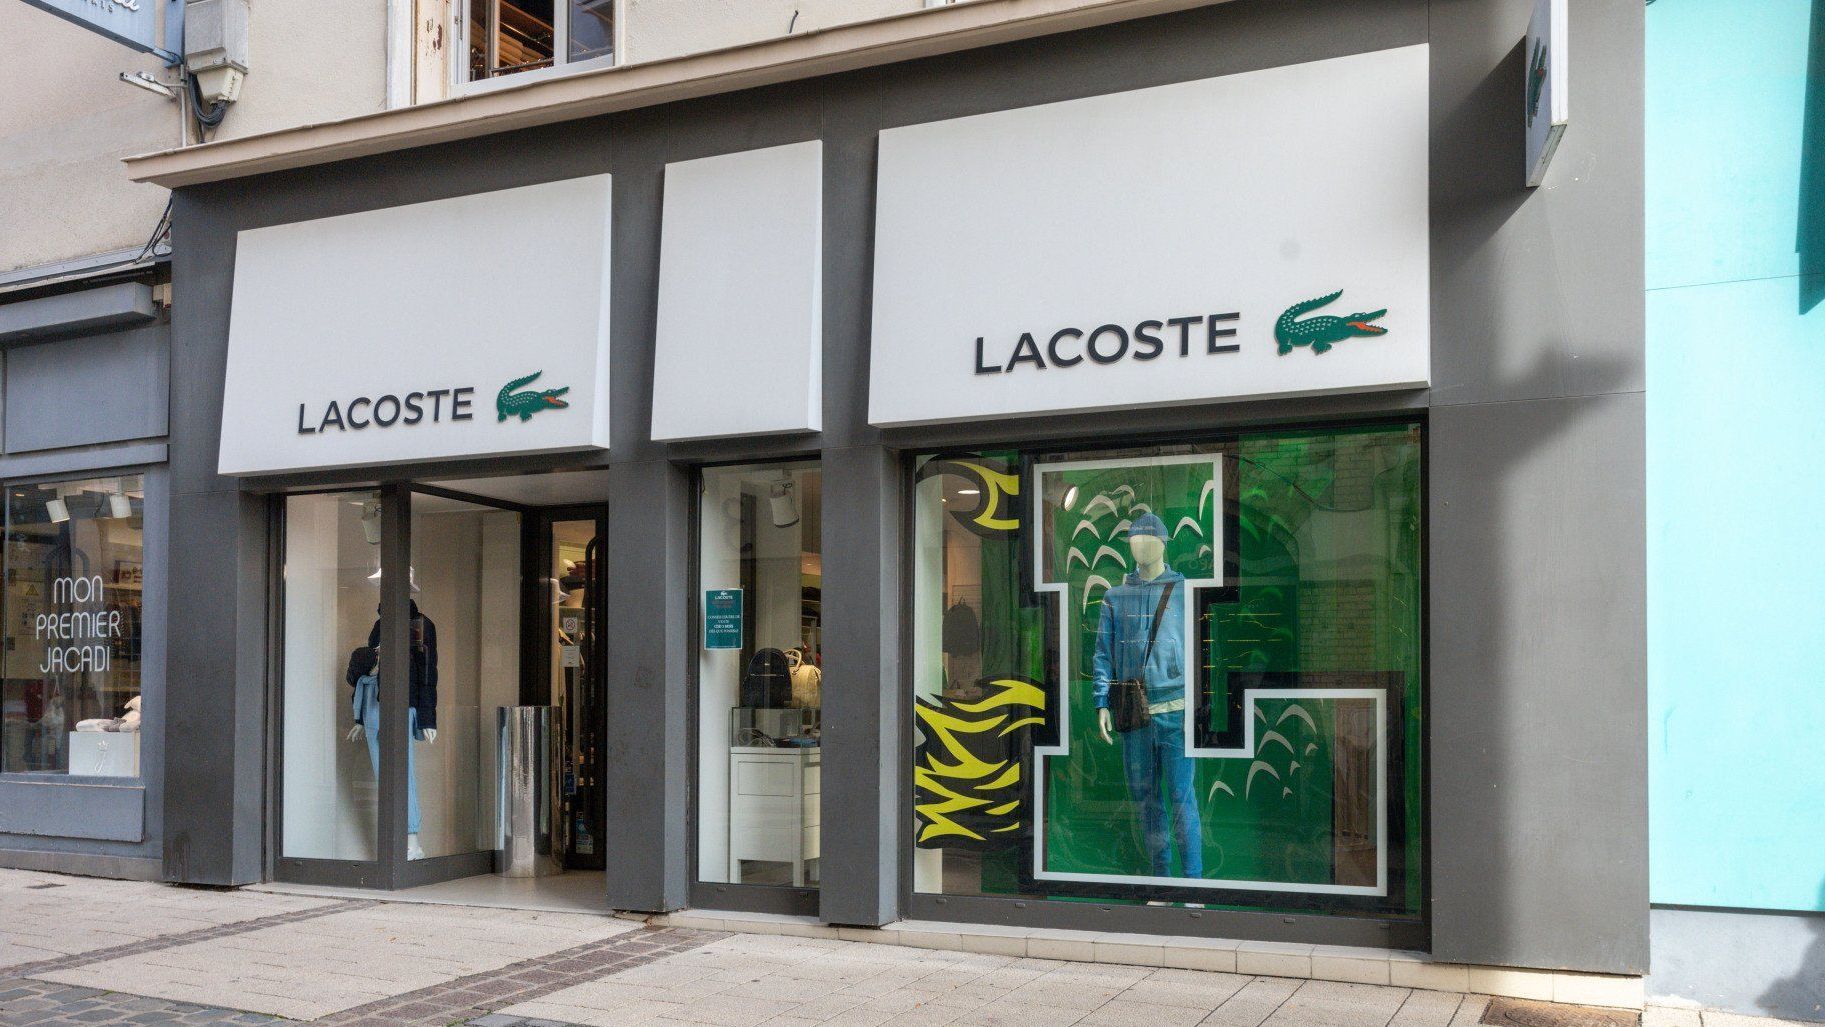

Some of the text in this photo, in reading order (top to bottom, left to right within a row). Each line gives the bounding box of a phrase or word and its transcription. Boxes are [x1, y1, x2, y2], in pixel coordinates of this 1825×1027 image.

[974, 312, 1240, 375] LACOSTE
[297, 386, 475, 435] LACOSTE
[36, 610, 121, 640] PREMIER
[40, 645, 110, 673] JACADI
